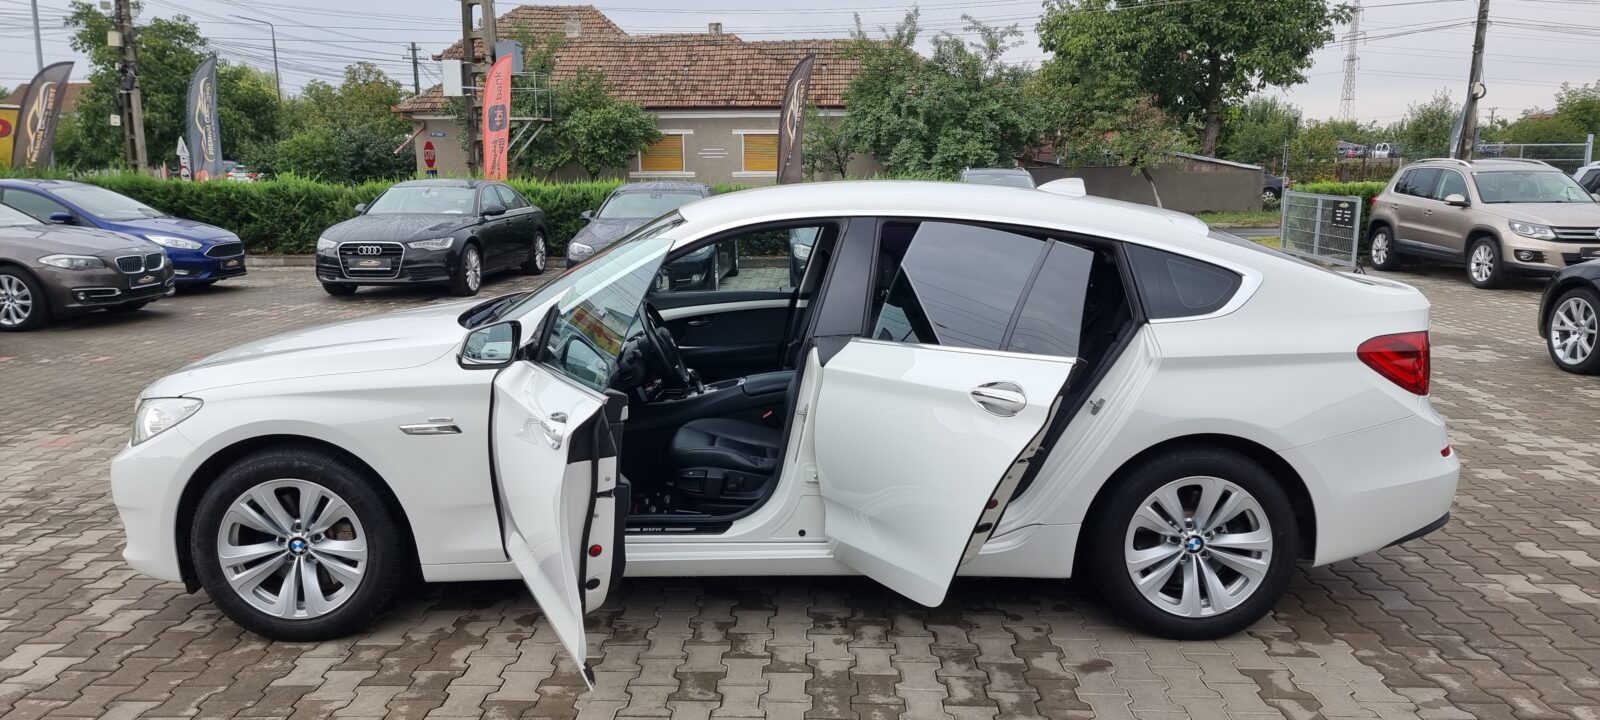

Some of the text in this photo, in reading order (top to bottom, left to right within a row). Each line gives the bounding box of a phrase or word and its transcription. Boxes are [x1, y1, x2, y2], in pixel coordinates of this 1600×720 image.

[494, 71, 503, 100] bank
[206, 124, 215, 156] PREMIUM
[425, 149, 435, 160] STOP
